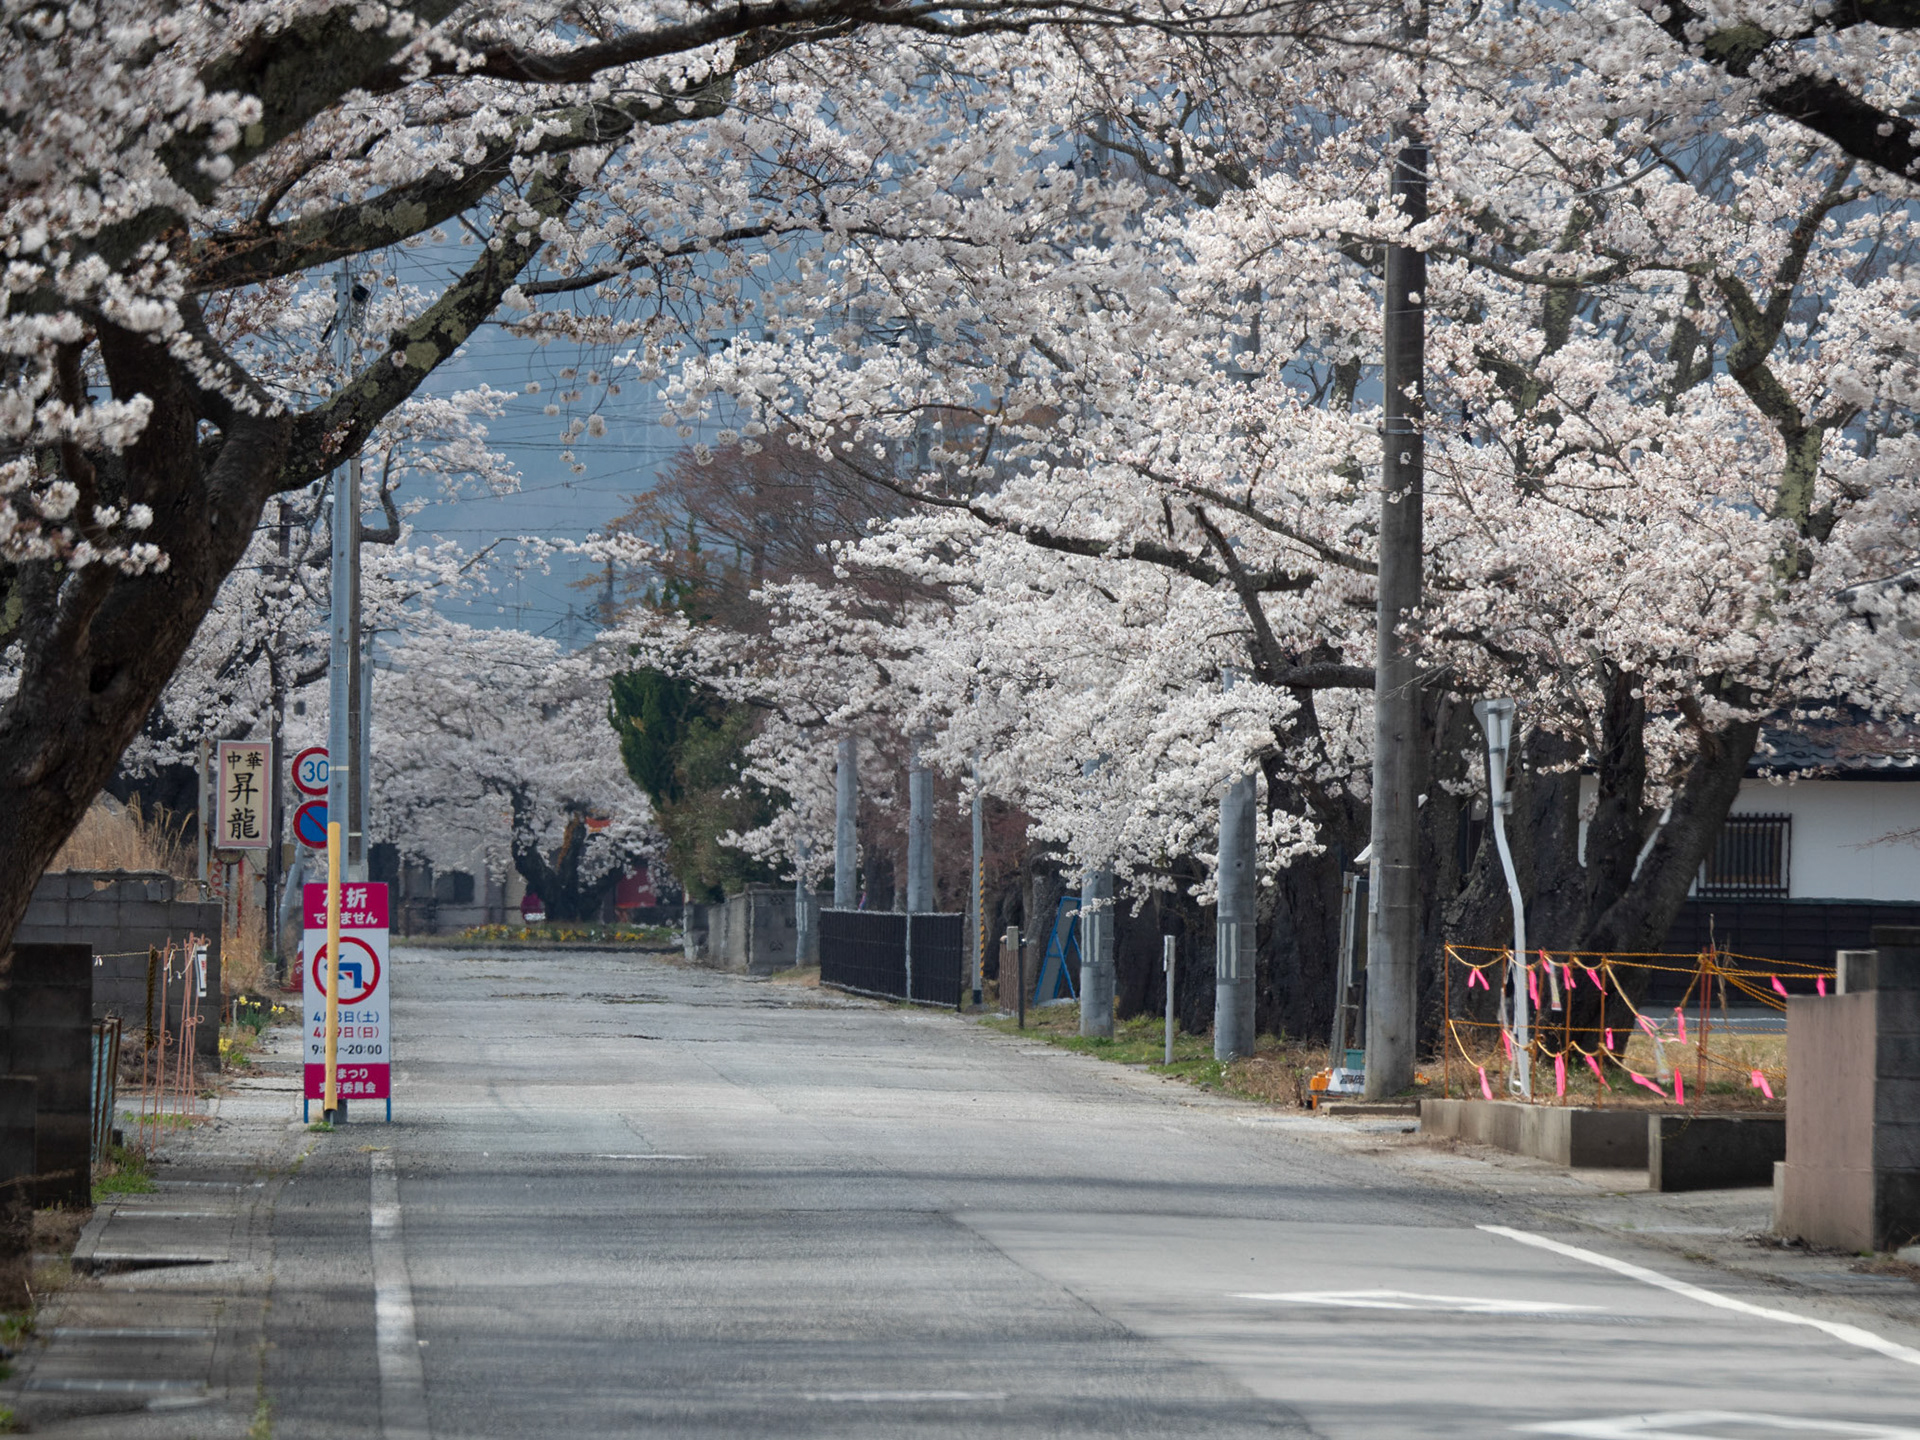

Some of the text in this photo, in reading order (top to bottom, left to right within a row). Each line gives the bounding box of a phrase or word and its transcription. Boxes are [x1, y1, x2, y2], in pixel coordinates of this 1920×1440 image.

[227, 751, 264, 770] 中華
[303, 761, 329, 782] 30
[227, 772, 260, 840] 昇龍
[313, 911, 378, 925] でません
[337, 1068, 369, 1079] まつり
